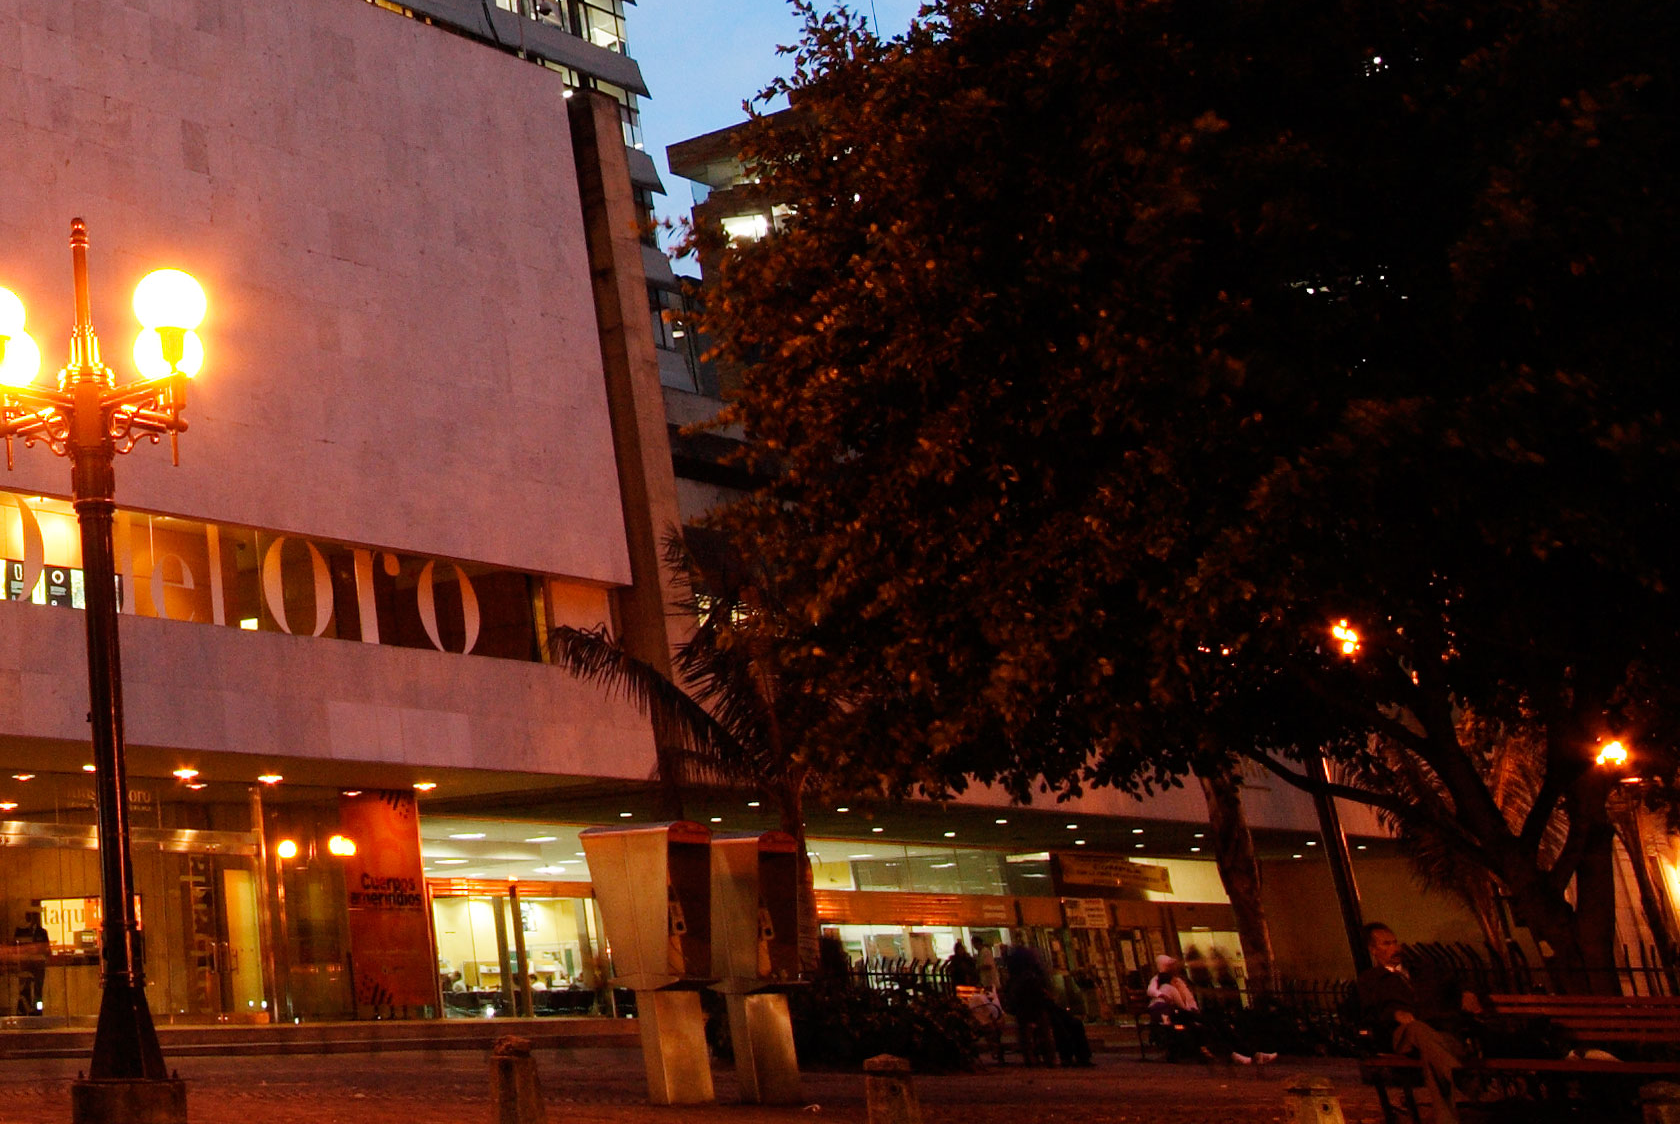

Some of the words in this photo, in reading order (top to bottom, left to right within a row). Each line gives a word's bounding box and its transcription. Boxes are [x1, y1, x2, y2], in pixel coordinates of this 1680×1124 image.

[262, 535, 480, 655] oro
[128, 789, 151, 804] oro
[361, 872, 415, 892] Cuerpos
